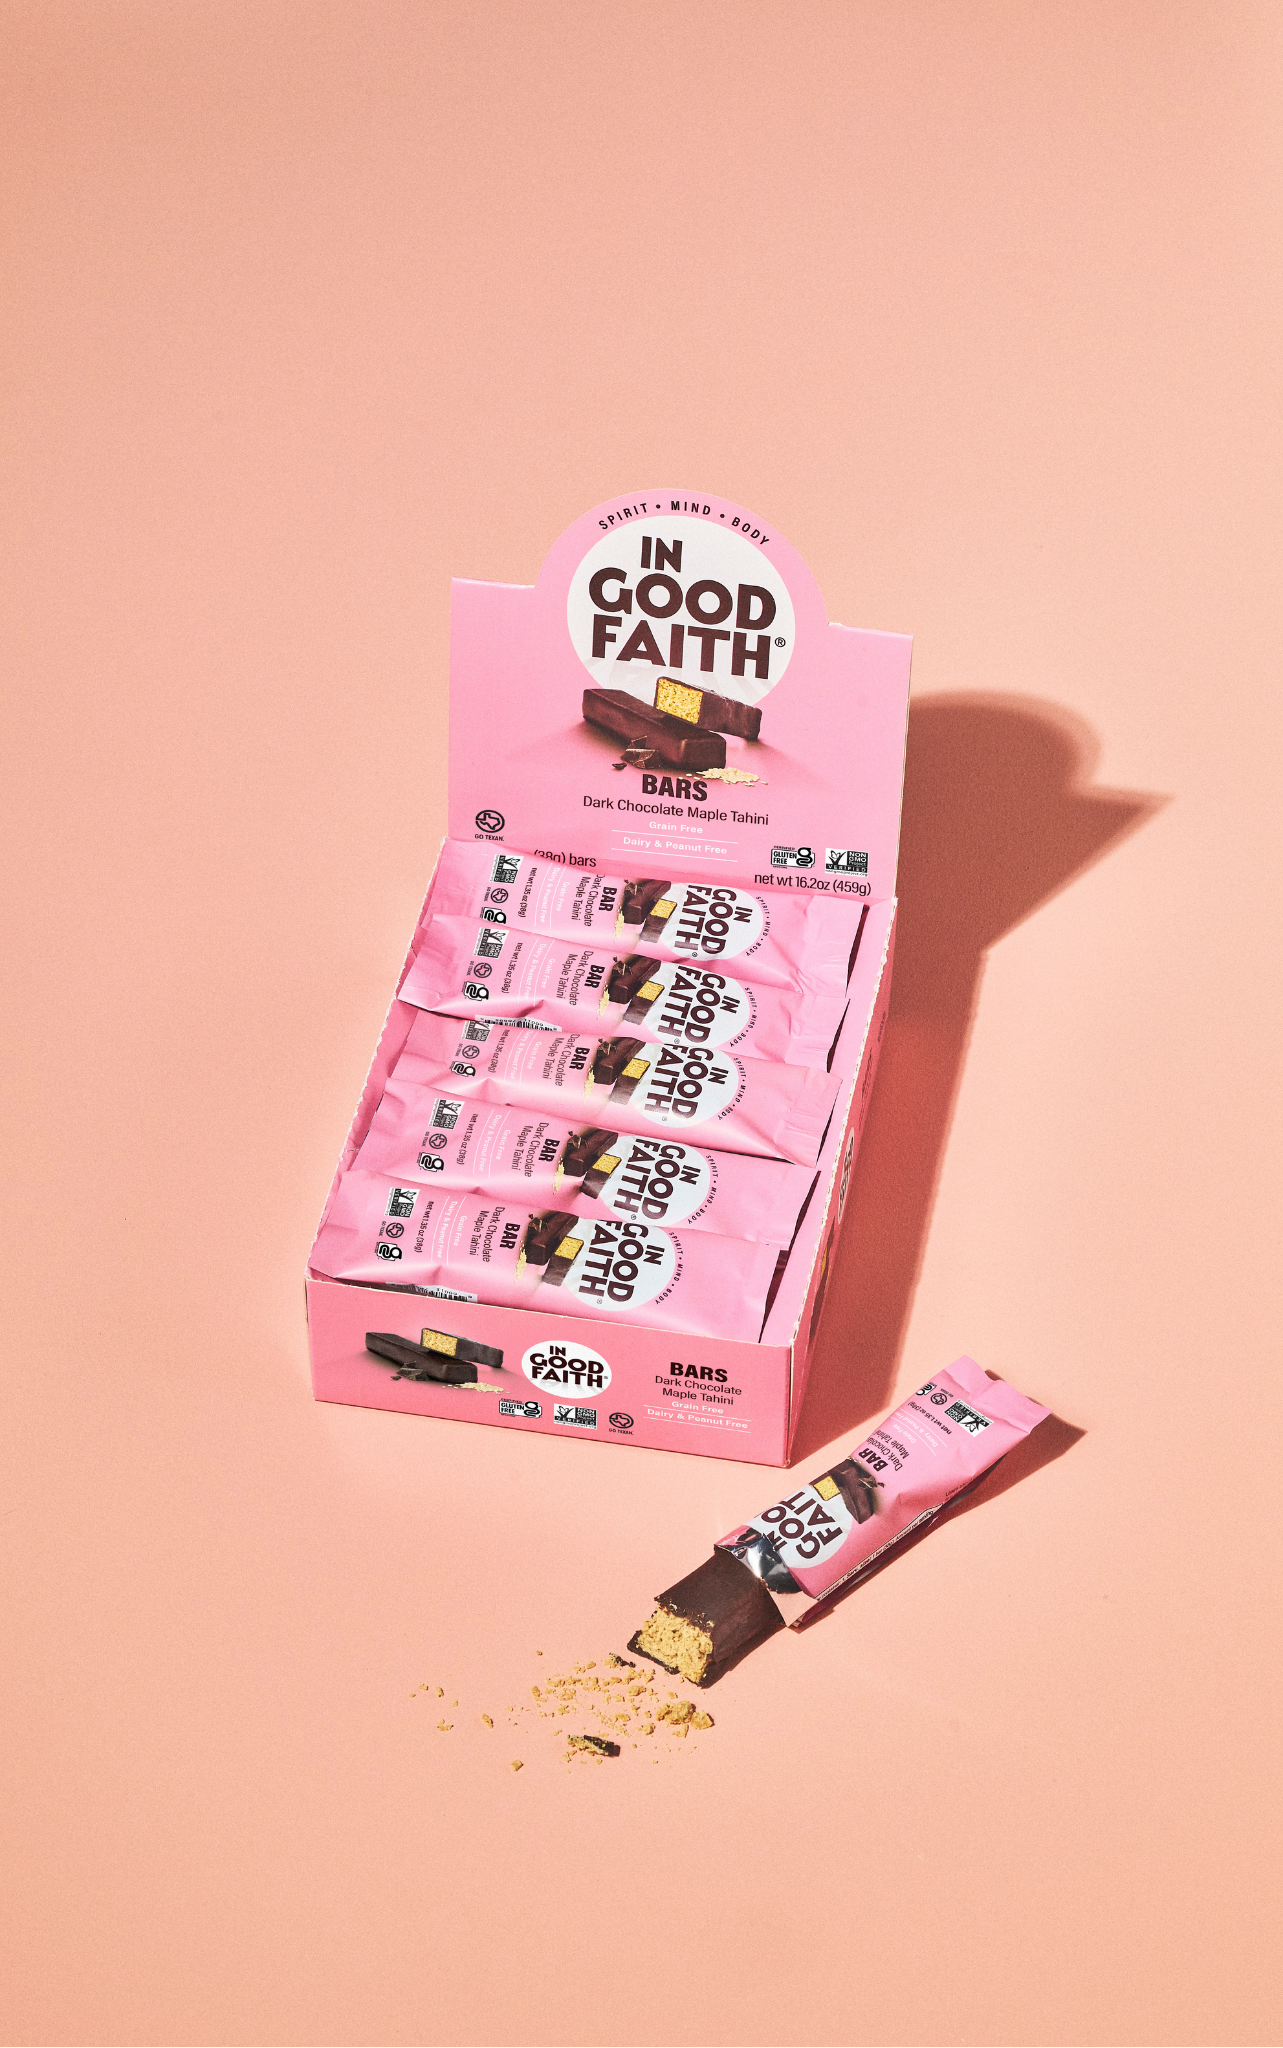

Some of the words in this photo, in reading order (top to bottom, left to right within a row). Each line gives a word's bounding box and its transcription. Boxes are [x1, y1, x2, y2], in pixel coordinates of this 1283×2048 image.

[598, 503, 648, 530] SPIRIT
[671, 500, 711, 515] MIND
[731, 517, 770, 545] BODY
[641, 535, 683, 573] IN
[588, 567, 777, 631] GOOD
[641, 773, 708, 802] BARS
[583, 795, 614, 810] Dark
[617, 799, 684, 817] Chocolate
[687, 806, 728, 822] Maple
[730, 810, 769, 826] Tahini
[649, 821, 677, 832] Grain
[680, 824, 703, 834] Free
[623, 836, 651, 849] Dairy
[654, 839, 663, 848] &
[665, 841, 702, 852] Peanut
[704, 845, 728, 855] Free
[773, 850, 798, 859] GLUTEN
[570, 852, 597, 867] bars
[560, 882, 570, 898] Grain
[576, 876, 592, 898] Maple
[754, 874, 774, 885] net
[776, 876, 793, 887] wt
[796, 876, 831, 890] 16.2oz
[833, 879, 871, 896] (459g)
[556, 898, 564, 912] Free
[584, 890, 599, 927] Chocolate
[598, 886, 618, 912] BAR
[572, 900, 584, 920] Tahini
[734, 906, 752, 923] IN
[700, 888, 737, 955] GOOD
[562, 954, 578, 976] Maple
[578, 950, 594, 970] Dark
[584, 964, 605, 988] BAR
[556, 978, 569, 999] Tahini
[569, 968, 586, 1006] Chocolate
[684, 973, 726, 1044] GOOD
[720, 995, 740, 1014] IN
[548, 1038, 564, 1057] Maple
[564, 1034, 580, 1050] Dark
[555, 1050, 572, 1086] Chocolate
[568, 1046, 590, 1070] BAR
[542, 1058, 556, 1080] Tahini
[708, 1066, 729, 1084] IN
[672, 1048, 714, 1119] GOOD
[500, 1130, 510, 1146] Grain
[516, 1125, 534, 1148] Maple
[532, 1122, 550, 1140] Dark
[496, 1146, 504, 1160] Free
[512, 1149, 524, 1170] Tahini
[524, 1140, 540, 1178] Chocolate
[538, 1138, 560, 1162] BAR
[678, 1164, 701, 1185] IN
[706, 1154, 718, 1178] SPIRIT
[641, 1144, 686, 1220] GOOD
[444, 1201, 458, 1216] Dairy
[490, 1206, 506, 1224] Dark
[456, 1216, 467, 1232] Grain
[474, 1210, 490, 1232] Maple
[438, 1224, 448, 1244] Peanut
[454, 1232, 462, 1247] Free
[482, 1224, 498, 1262] Chocolate
[500, 1222, 520, 1250] BAR
[669, 1232, 684, 1254] SPIRIT
[436, 1244, 444, 1258] Free
[469, 1234, 482, 1256] Tahini
[643, 1244, 665, 1266] IN
[606, 1222, 648, 1302] GOOD
[549, 1345, 566, 1356] IN
[529, 1352, 604, 1374] GOOD
[670, 1362, 728, 1383] BARS
[655, 1376, 682, 1387] Dark
[684, 1380, 742, 1396] Chocolate
[662, 1388, 697, 1400] Maple
[700, 1392, 734, 1405] Tahini
[501, 1402, 524, 1410] GLUTEN
[672, 1401, 699, 1410] Grain
[702, 1405, 724, 1414] Free
[647, 1408, 674, 1419] Dairy
[677, 1412, 685, 1420] &
[688, 1414, 723, 1425] Peanut
[726, 1420, 748, 1428] Free
[902, 1430, 916, 1444] Grain
[924, 1432, 938, 1448] Dairy
[858, 1448, 888, 1472] BAR
[891, 1440, 910, 1459] Maple
[888, 1453, 903, 1472] Dark
[779, 1491, 844, 1546] FAIT
[760, 1506, 820, 1559] GOO
